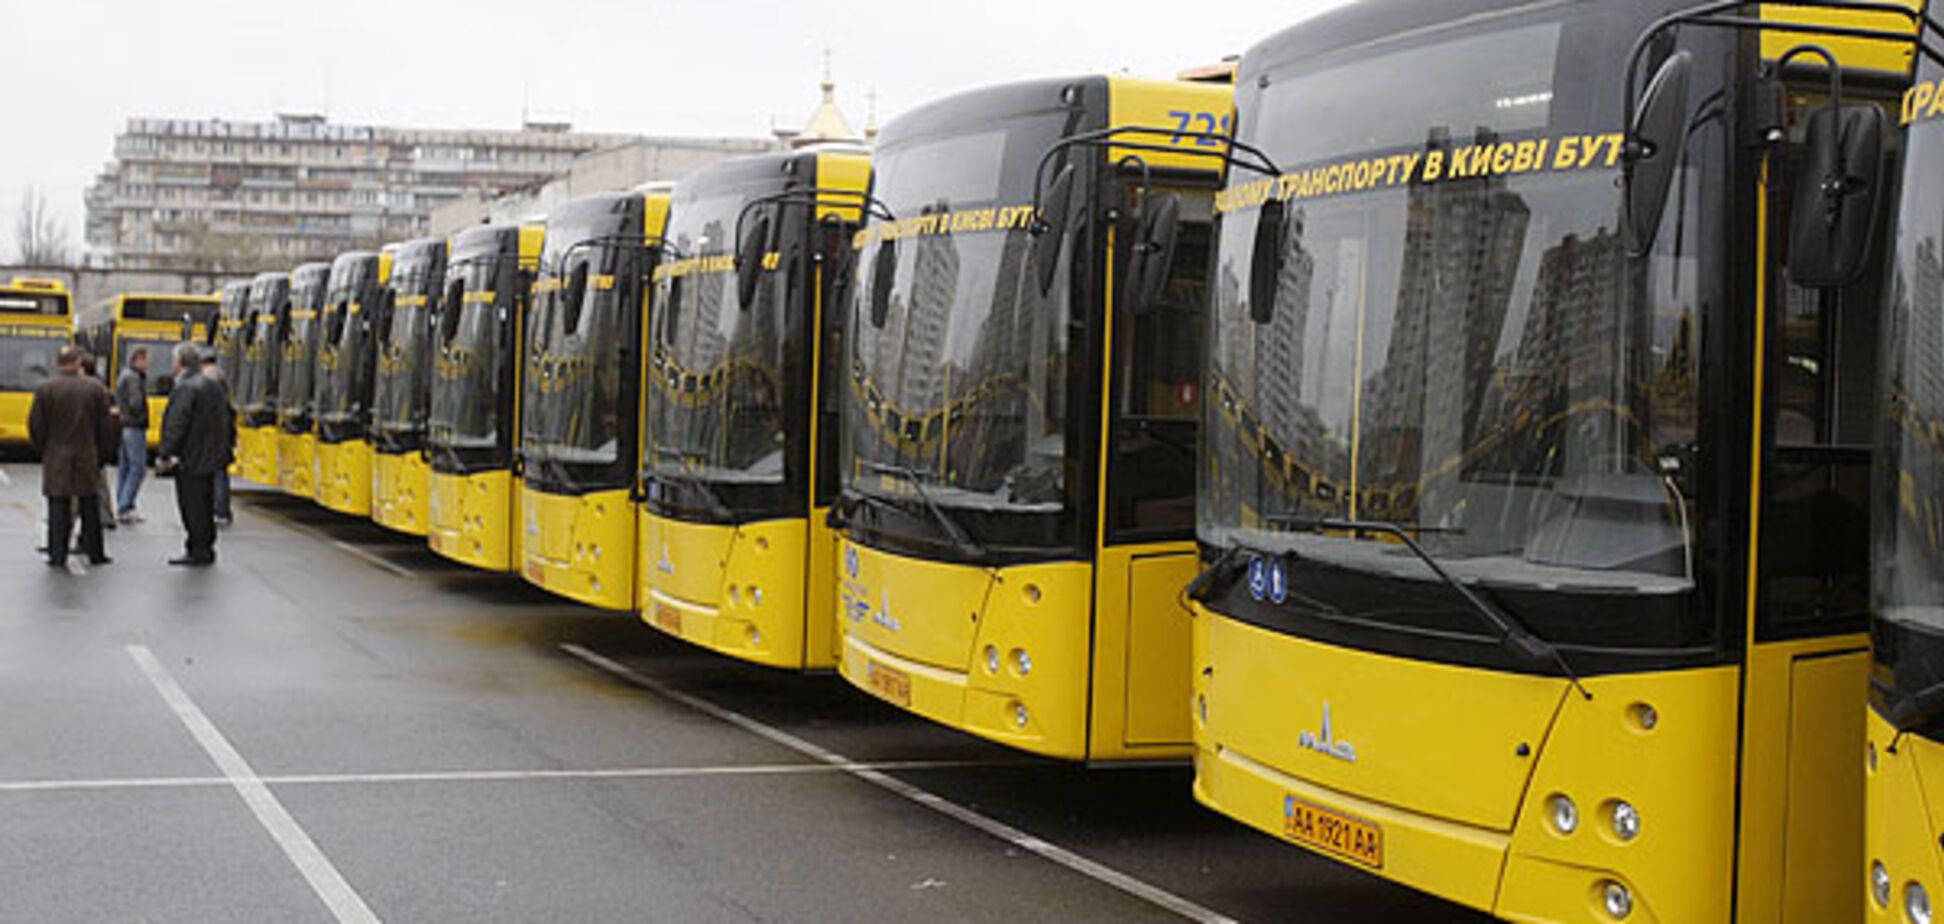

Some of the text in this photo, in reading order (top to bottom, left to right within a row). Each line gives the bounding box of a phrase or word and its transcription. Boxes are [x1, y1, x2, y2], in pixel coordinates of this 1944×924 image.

[1276, 152, 1421, 201] ТРАНСПОРТУ
[1422, 149, 1444, 181] В
[1447, 138, 1549, 179] КИЄВІ
[1552, 132, 1625, 169] БУТ
